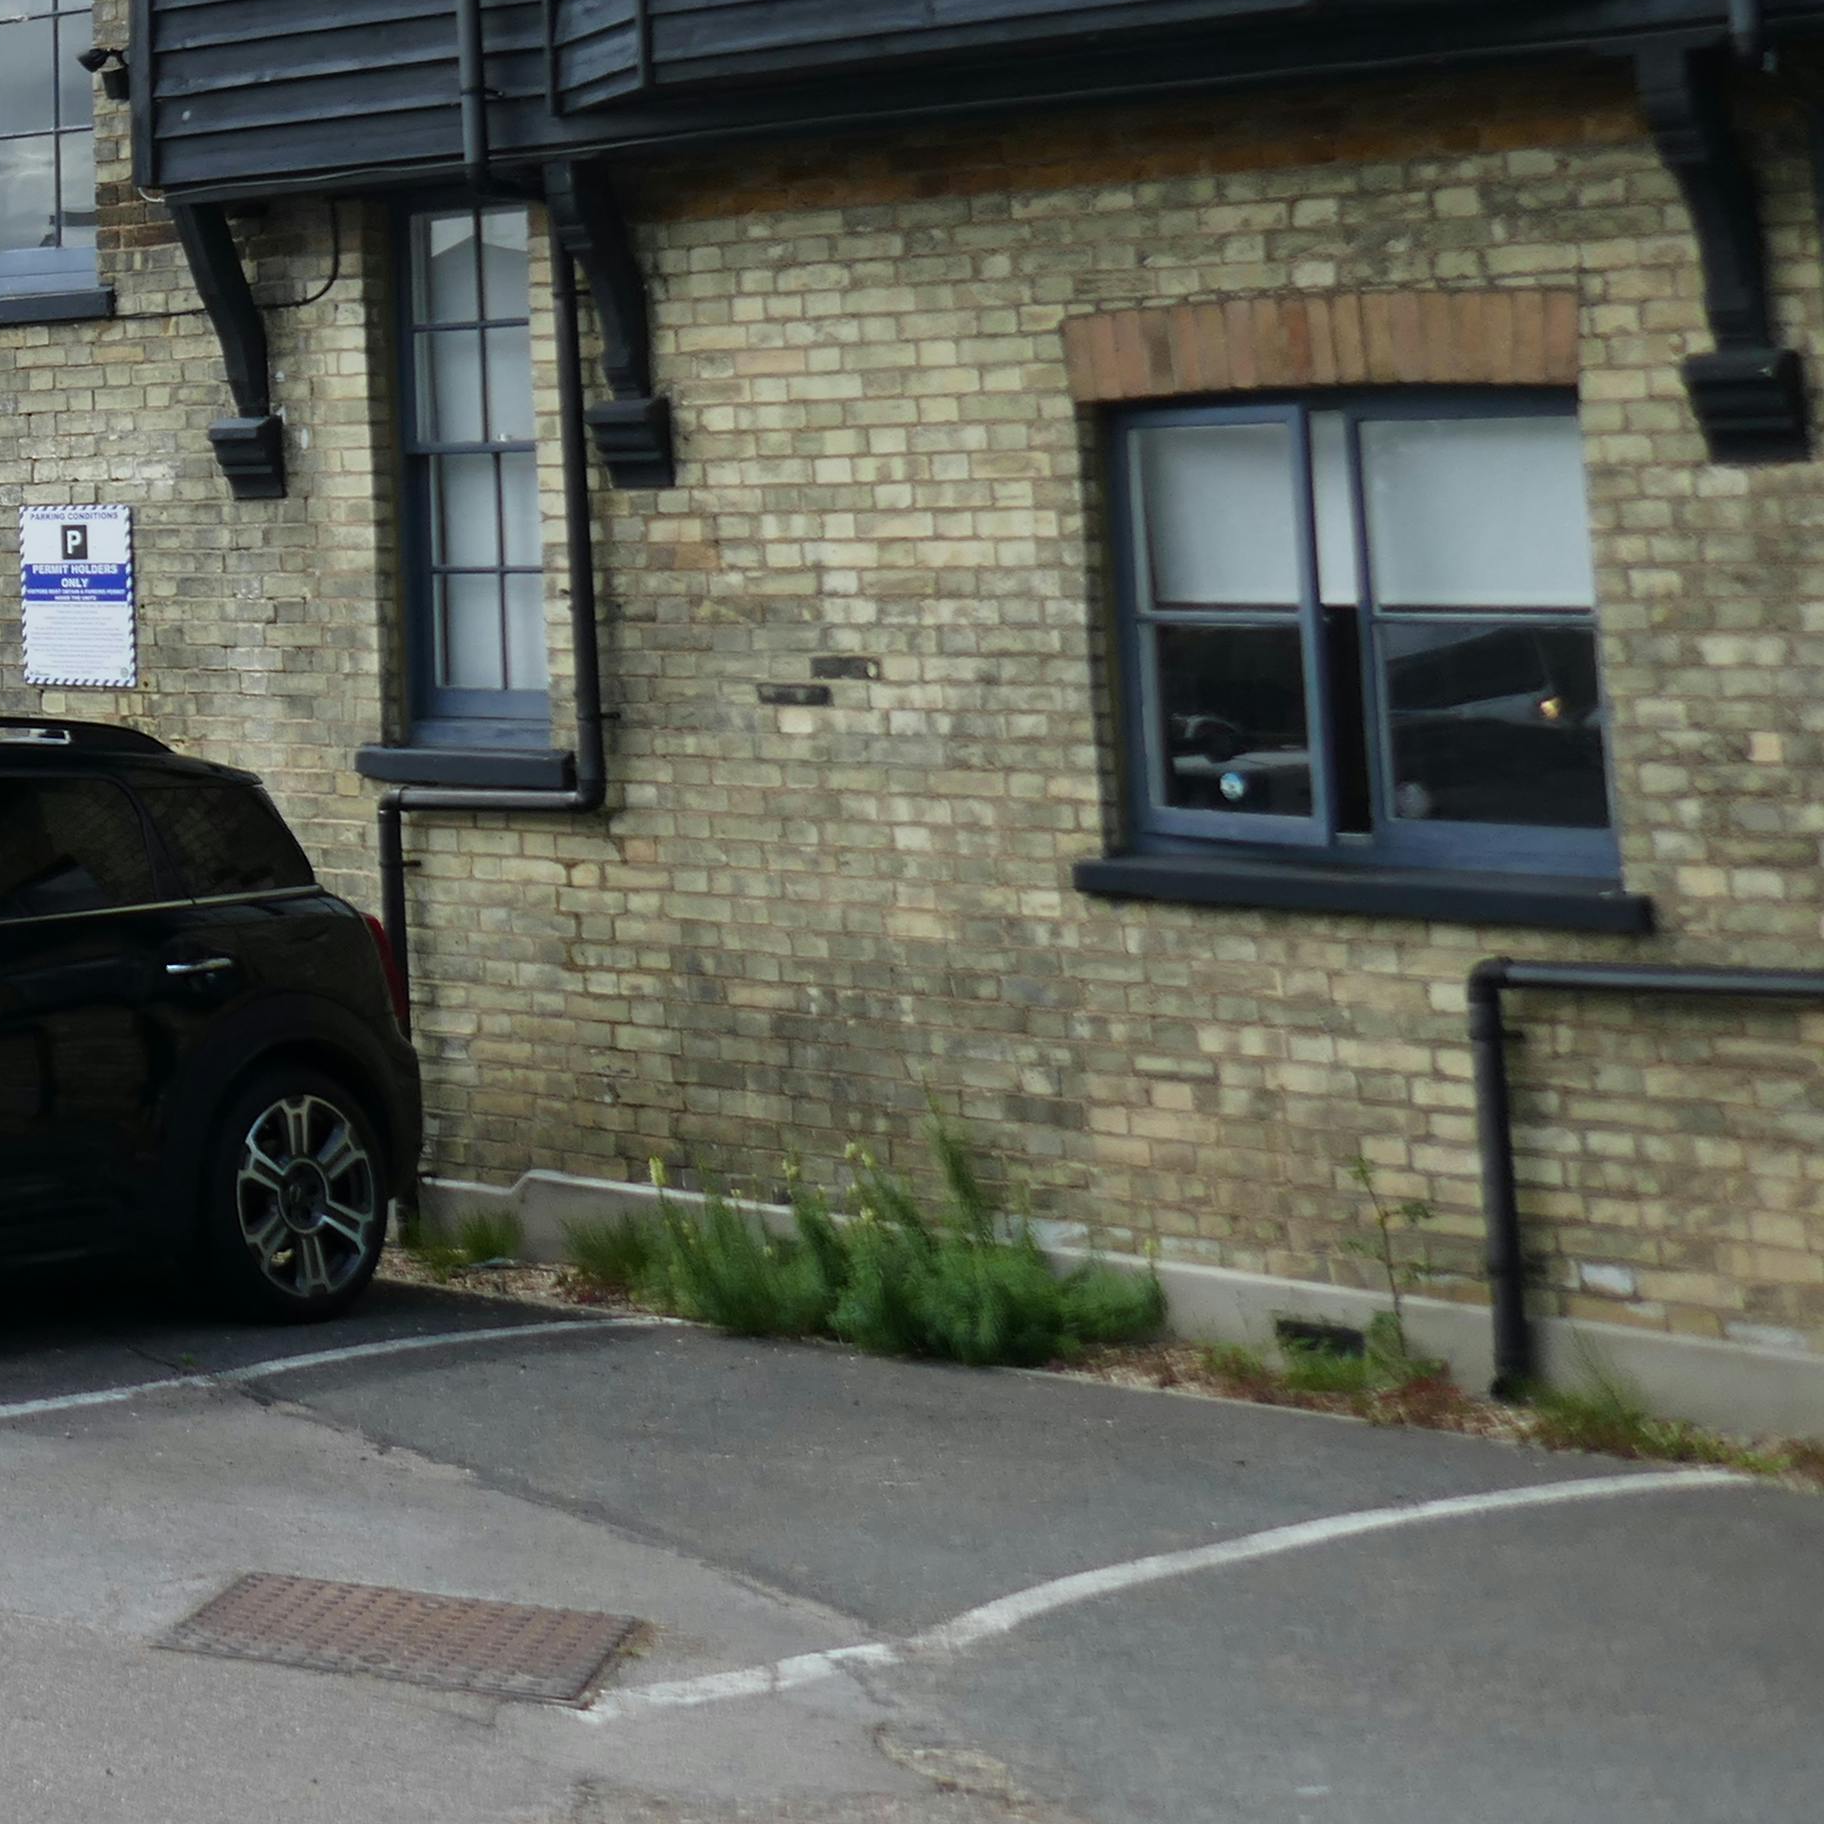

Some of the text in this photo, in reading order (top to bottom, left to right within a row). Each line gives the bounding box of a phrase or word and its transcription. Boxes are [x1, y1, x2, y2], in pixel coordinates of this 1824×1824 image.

[31, 511, 119, 521] PARKING CONDITIONS
[66, 530, 82, 555] P
[32, 564, 119, 575] PERMIT HOLDERS
[60, 577, 89, 588] ONLY
